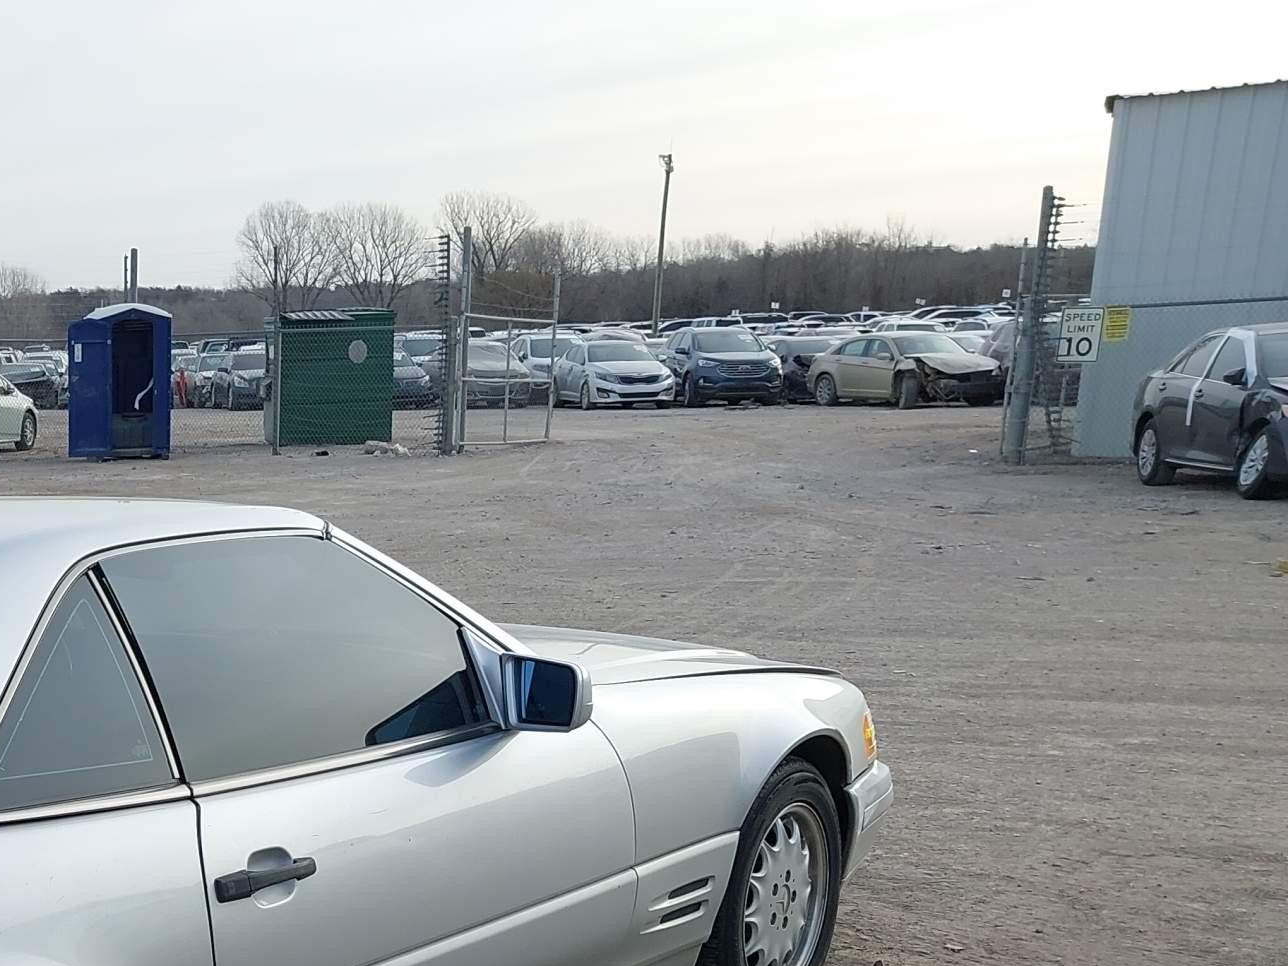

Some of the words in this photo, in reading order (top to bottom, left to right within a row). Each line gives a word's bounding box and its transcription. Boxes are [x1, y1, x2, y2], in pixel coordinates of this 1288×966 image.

[1065, 313, 1101, 321] SPEED
[1067, 325, 1095, 333] LIMIT
[1066, 337, 1092, 356] 10
